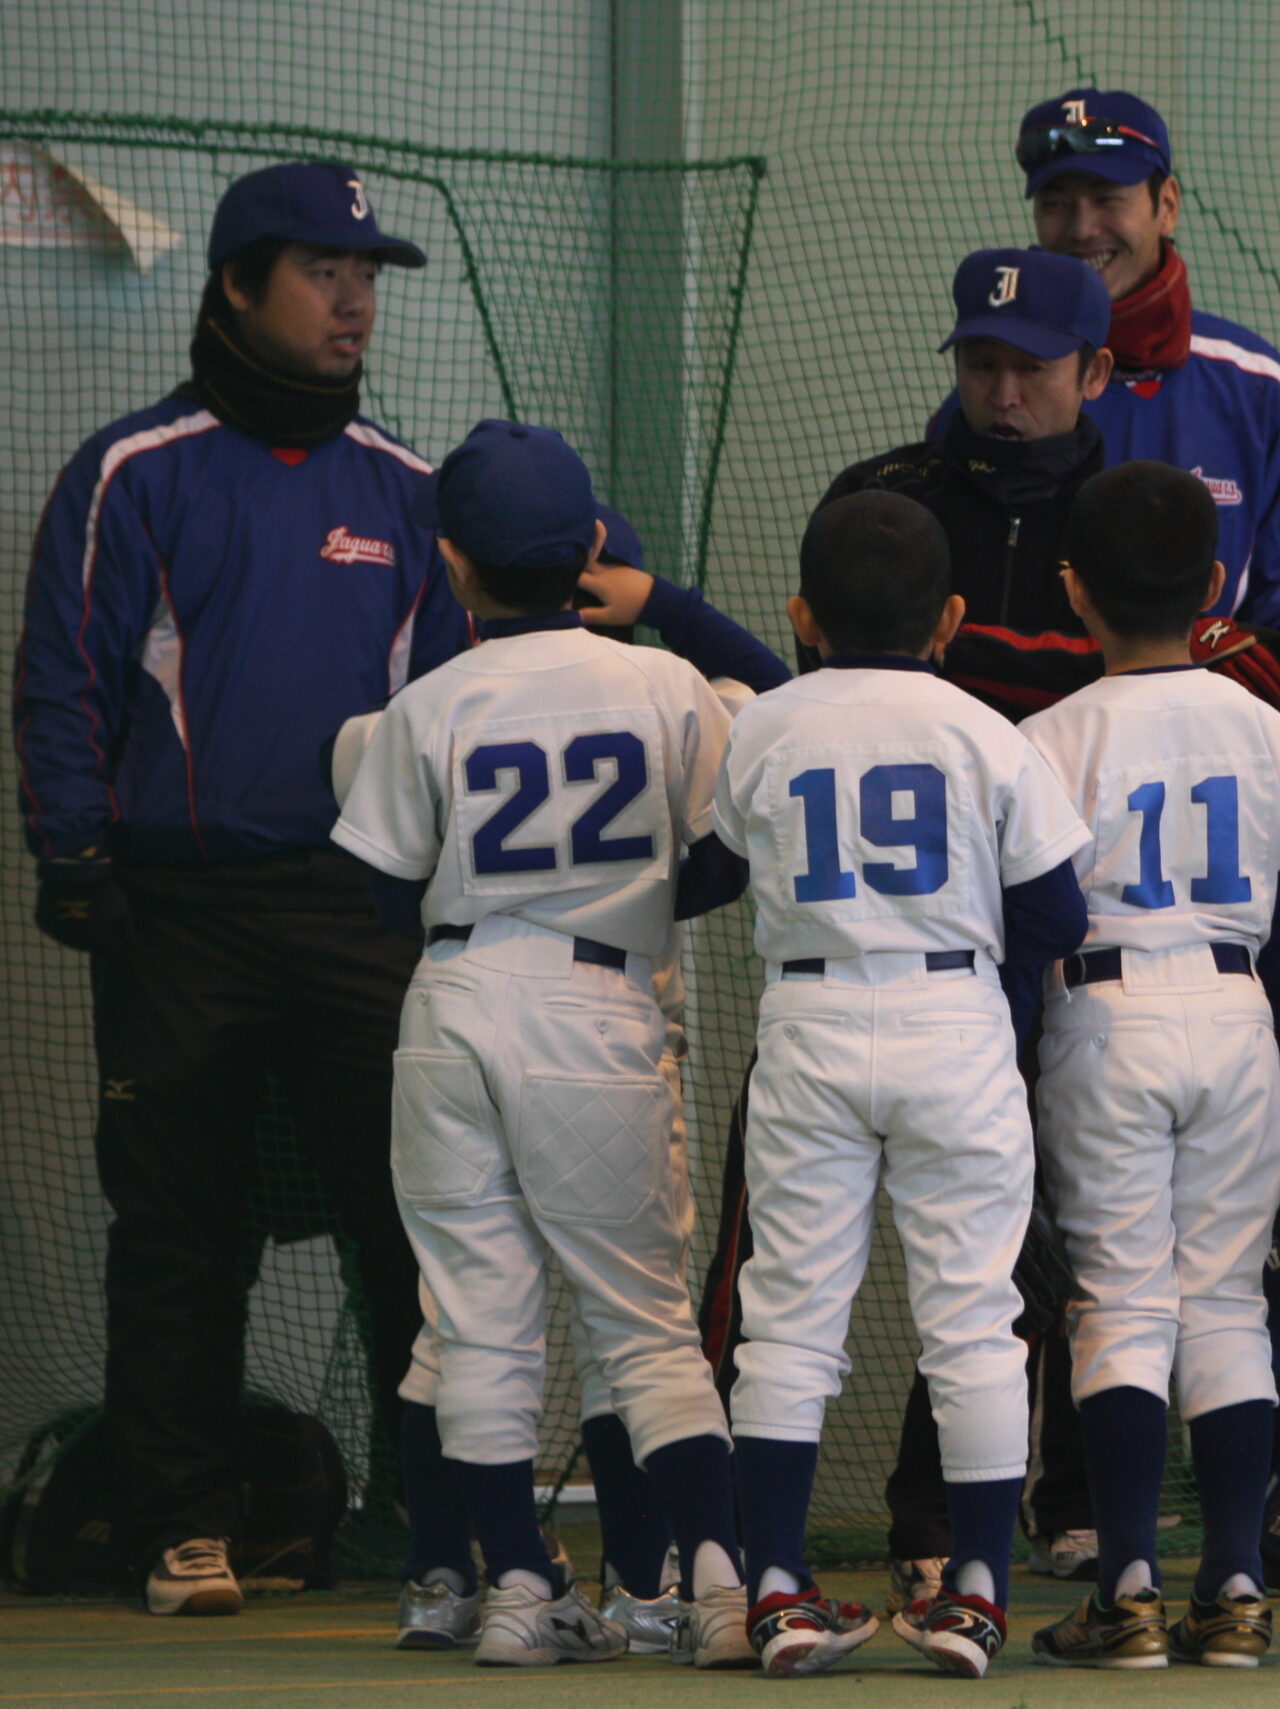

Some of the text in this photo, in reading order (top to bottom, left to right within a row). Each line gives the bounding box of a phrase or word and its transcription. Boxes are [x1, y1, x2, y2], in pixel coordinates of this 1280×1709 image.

[989, 266, 1020, 307] J
[463, 730, 656, 877] 22
[788, 763, 950, 904] 19
[1120, 775, 1253, 910] 11
